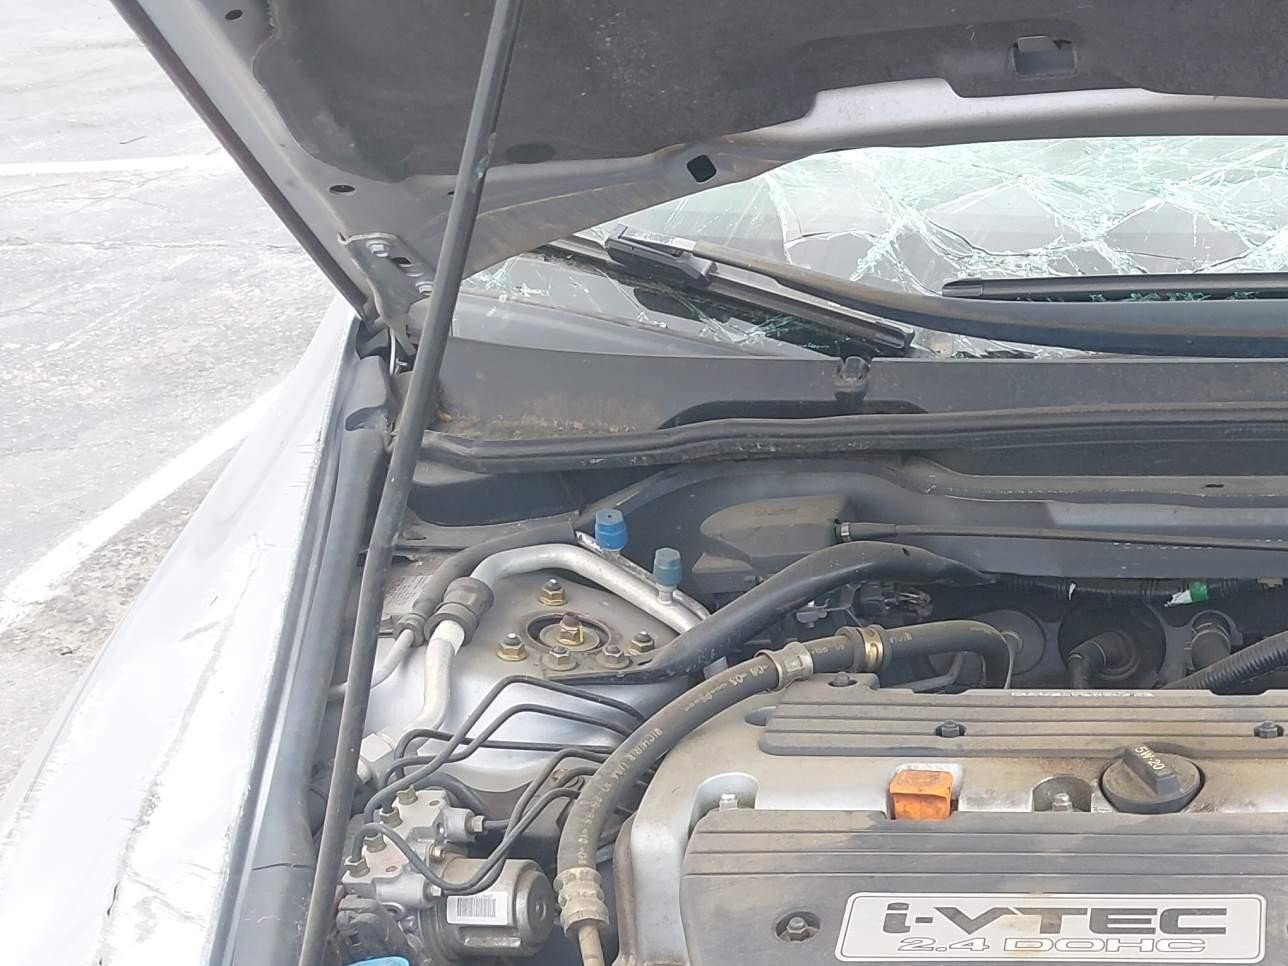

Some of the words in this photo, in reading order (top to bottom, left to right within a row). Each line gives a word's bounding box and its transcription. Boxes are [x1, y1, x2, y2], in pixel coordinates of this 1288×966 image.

[1134, 745, 1166, 771] 5W-20
[883, 902, 1228, 935] i-VTEC
[898, 937, 990, 952] 2.4
[1003, 938, 1206, 953] DOHC
